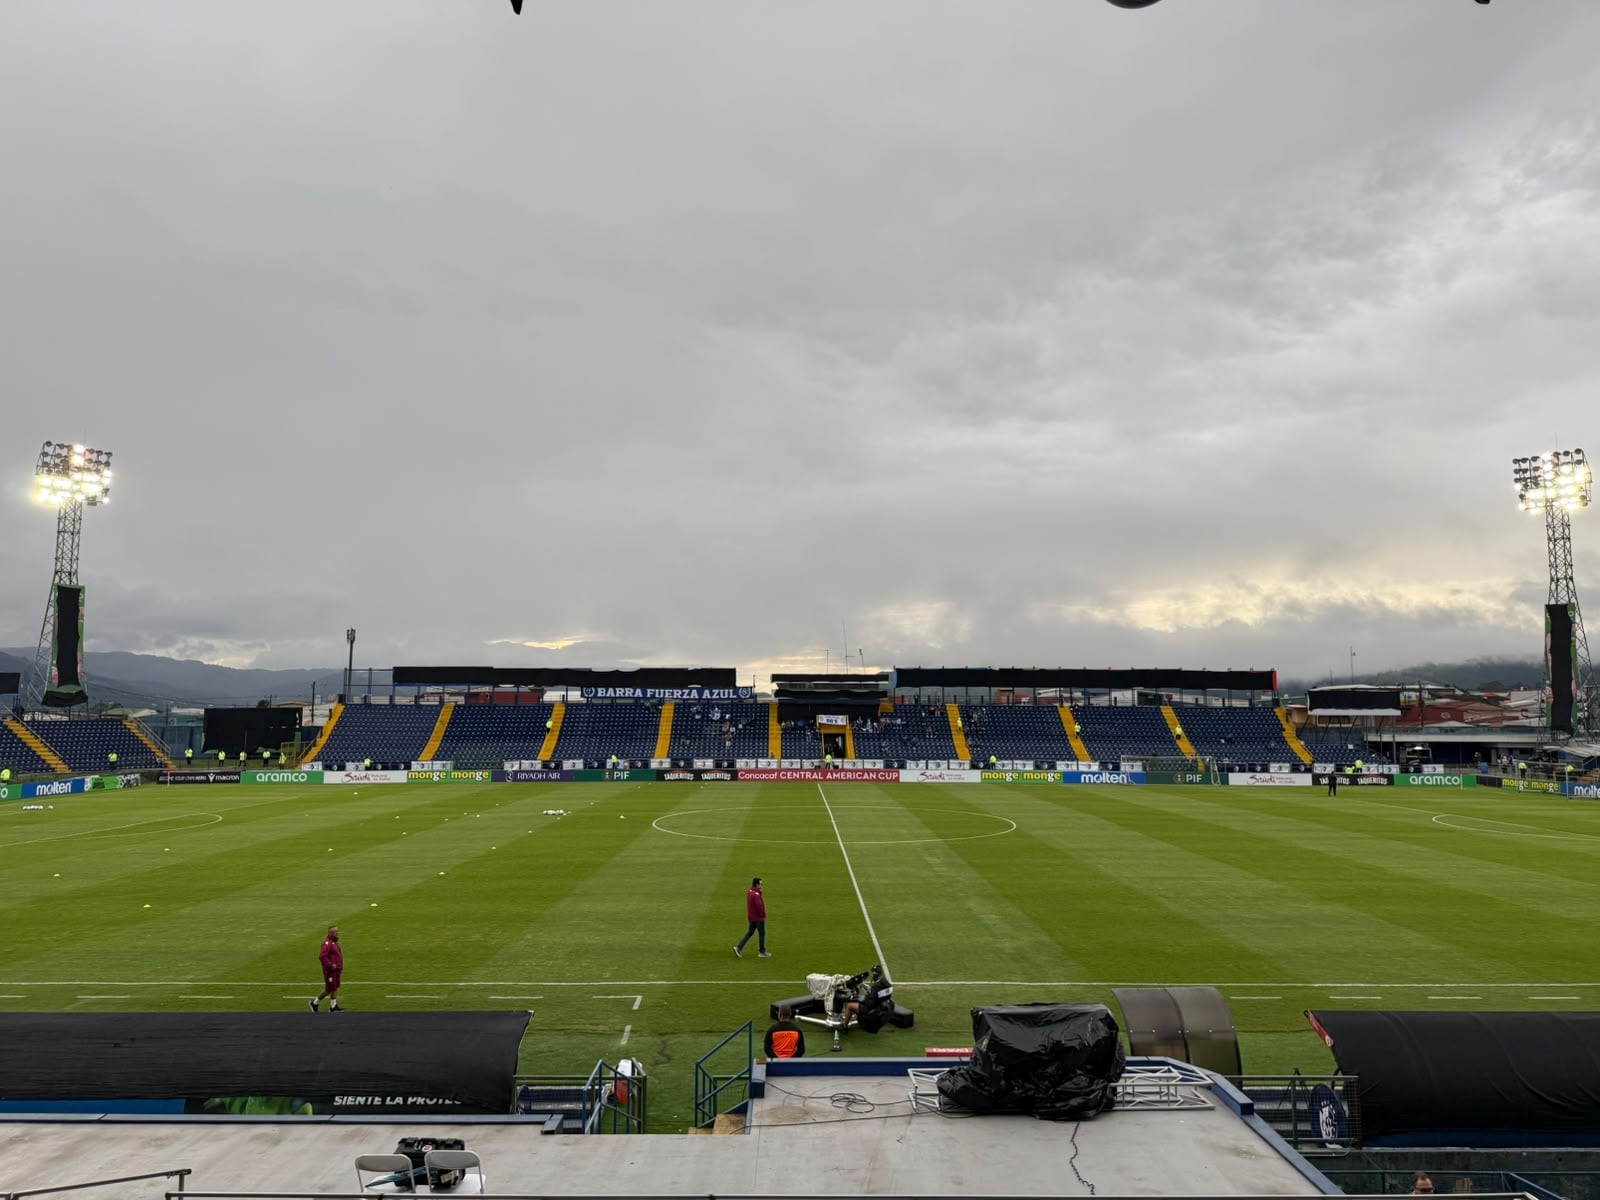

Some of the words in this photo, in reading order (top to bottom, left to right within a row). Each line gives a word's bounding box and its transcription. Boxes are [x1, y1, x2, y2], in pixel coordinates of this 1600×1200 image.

[597, 687, 643, 697] BARRA
[646, 689, 699, 698] FUERZA
[702, 688, 737, 698] AZUL
[256, 772, 307, 782] aramco
[408, 770, 447, 782] monge
[451, 770, 489, 782] monge
[517, 772, 546, 780] RIYADH
[548, 772, 561, 780] AIR
[613, 771, 630, 780] PIF
[738, 771, 778, 780] Concacaf
[779, 771, 823, 780] CENTRAL
[826, 771, 875, 780] AMERICAN
[877, 771, 899, 780] CUP
[982, 771, 1019, 783] monge
[1023, 771, 1061, 783] monge
[1081, 773, 1127, 783] molten
[1186, 774, 1202, 783] PIF
[1409, 775, 1460, 785] aramco
[36, 781, 72, 796] molten
[1531, 782, 1559, 793] monge
[333, 1095, 382, 1106] SIENTE
[385, 1096, 404, 1105] LA
